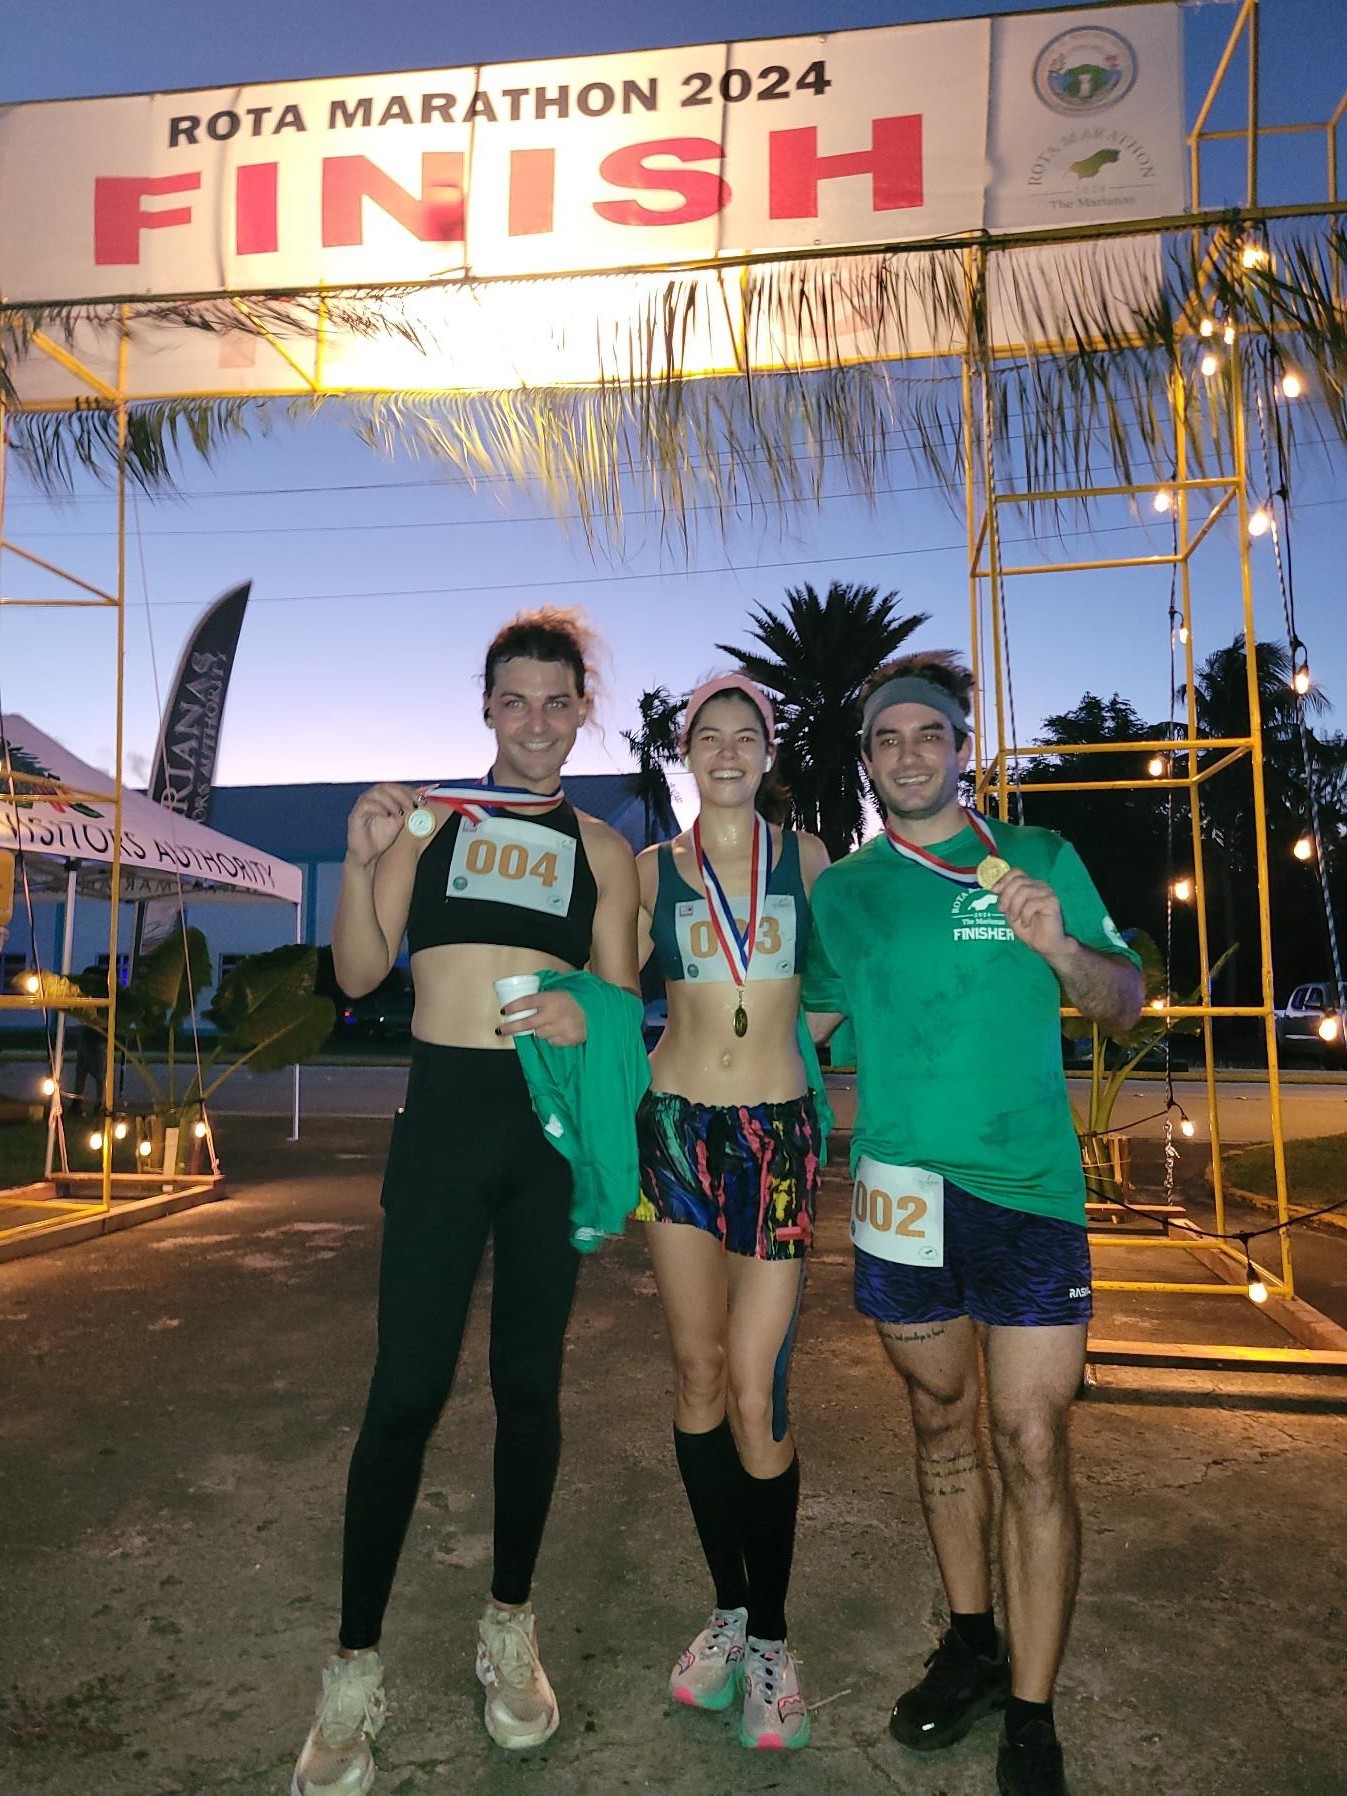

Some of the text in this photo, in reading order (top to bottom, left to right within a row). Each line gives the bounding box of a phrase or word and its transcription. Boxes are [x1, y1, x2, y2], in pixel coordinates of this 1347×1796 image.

[168, 59, 833, 148] ROTA MARATHON 2024
[1028, 128, 1156, 186] ROTA MARATHON
[94, 113, 923, 265] FINISH
[1048, 200, 1074, 210] The
[153, 838, 276, 889] AUTHORITY
[465, 838, 558, 888] 004
[951, 893, 968, 914] ROTA
[690, 915, 783, 959] 03
[953, 927, 1015, 942] FINISHER
[855, 1181, 928, 1239] 002
